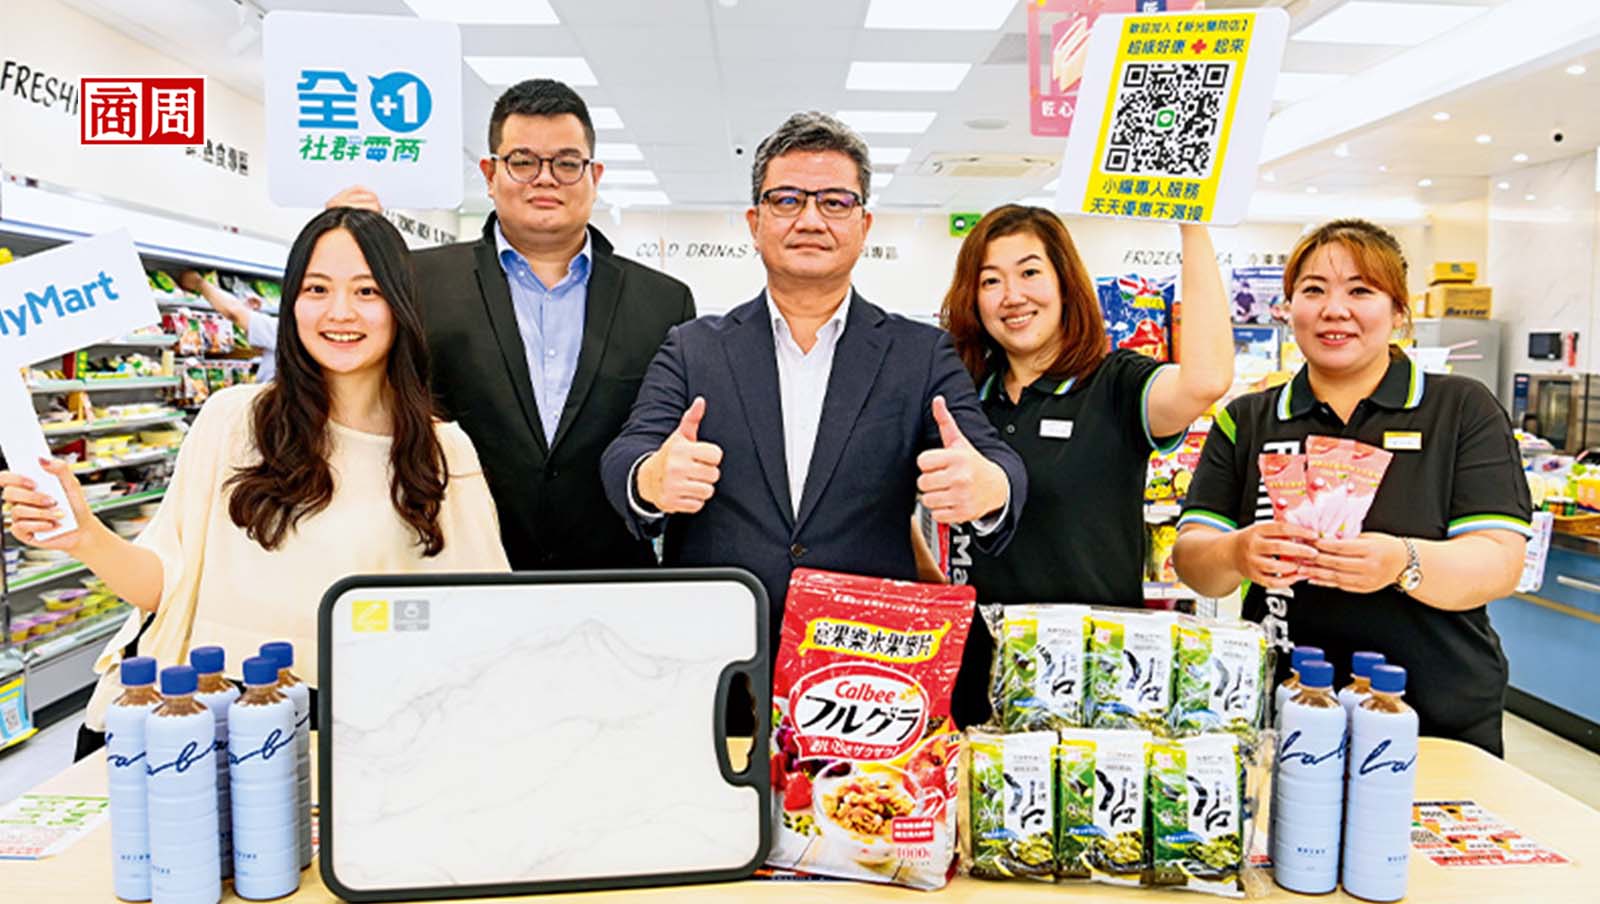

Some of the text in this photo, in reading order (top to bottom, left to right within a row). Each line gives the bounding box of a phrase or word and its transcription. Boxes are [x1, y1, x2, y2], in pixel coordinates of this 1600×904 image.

[298, 134, 427, 163] 社群電商
[812, 620, 934, 657] 富果樂水果麥片
[835, 680, 897, 704] Calbee
[801, 694, 921, 742] フルグラ
